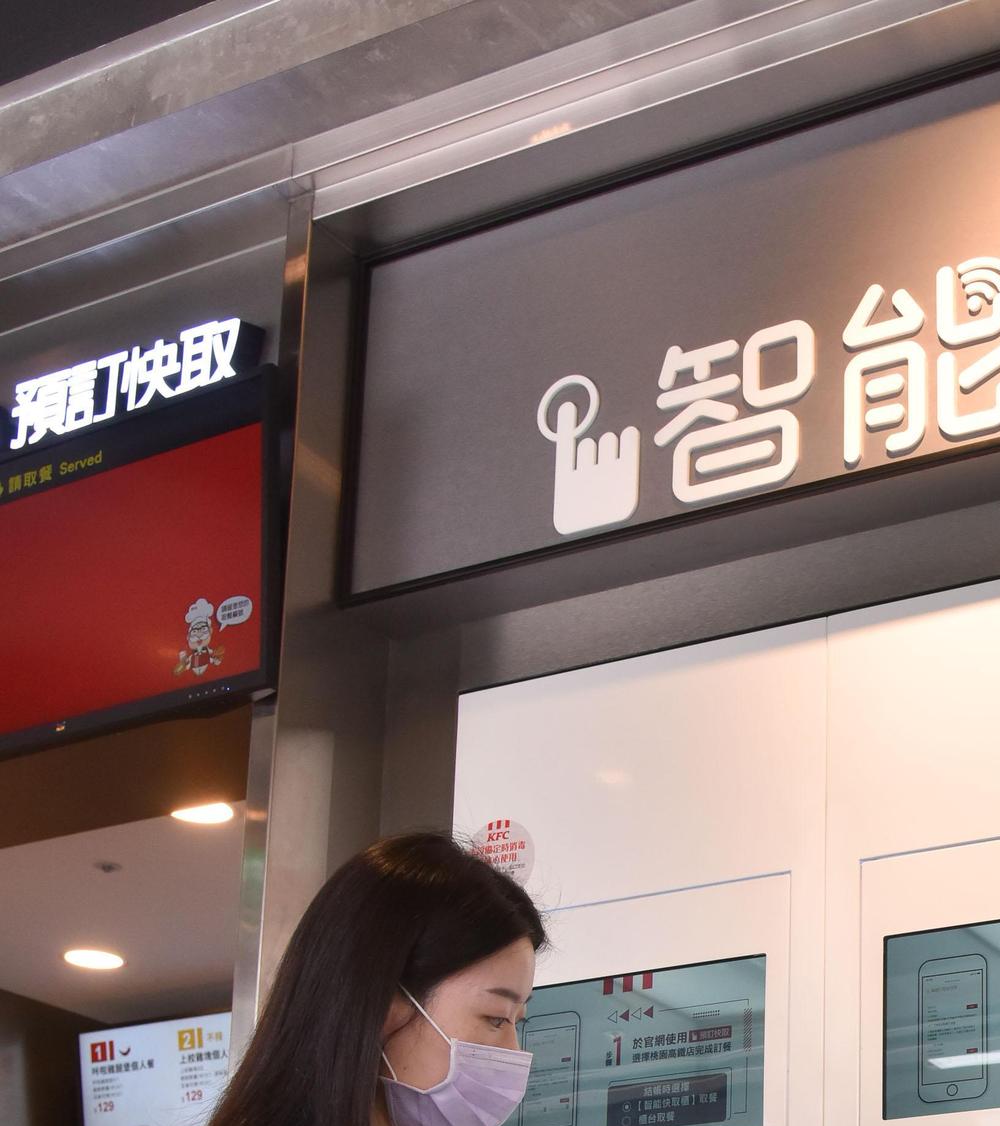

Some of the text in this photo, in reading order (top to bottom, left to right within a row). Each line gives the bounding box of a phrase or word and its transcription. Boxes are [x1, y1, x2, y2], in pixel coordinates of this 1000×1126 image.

[9, 317, 241, 450] 預訂快取
[59, 449, 103, 476] Served
[486, 830, 510, 842] KFC
[613, 1036, 622, 1066] 1
